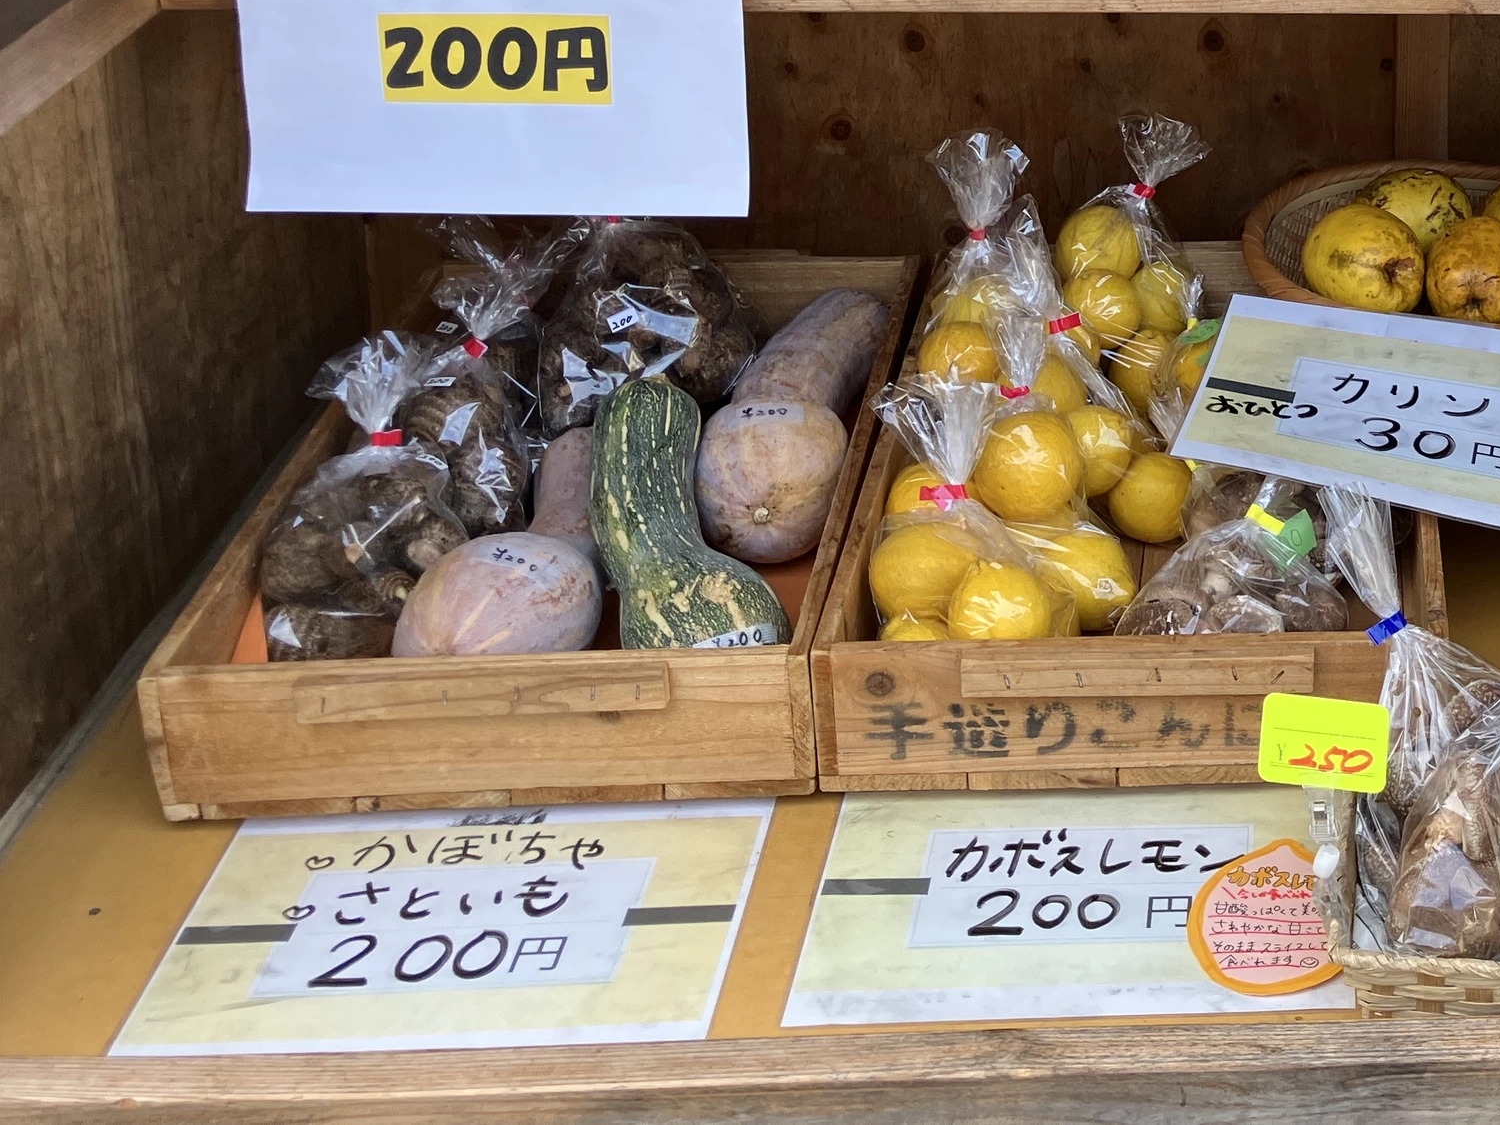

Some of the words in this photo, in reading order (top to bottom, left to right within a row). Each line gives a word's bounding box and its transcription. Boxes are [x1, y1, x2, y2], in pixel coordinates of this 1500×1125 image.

[383, 25, 609, 93] 200円
[612, 315, 634, 329] 200
[1205, 394, 1319, 420] おひとつ
[1331, 372, 1491, 418] カリン
[354, 830, 604, 873] かぼちゃ
[335, 876, 568, 925] さといも
[1219, 953, 1293, 968] 食べれます
